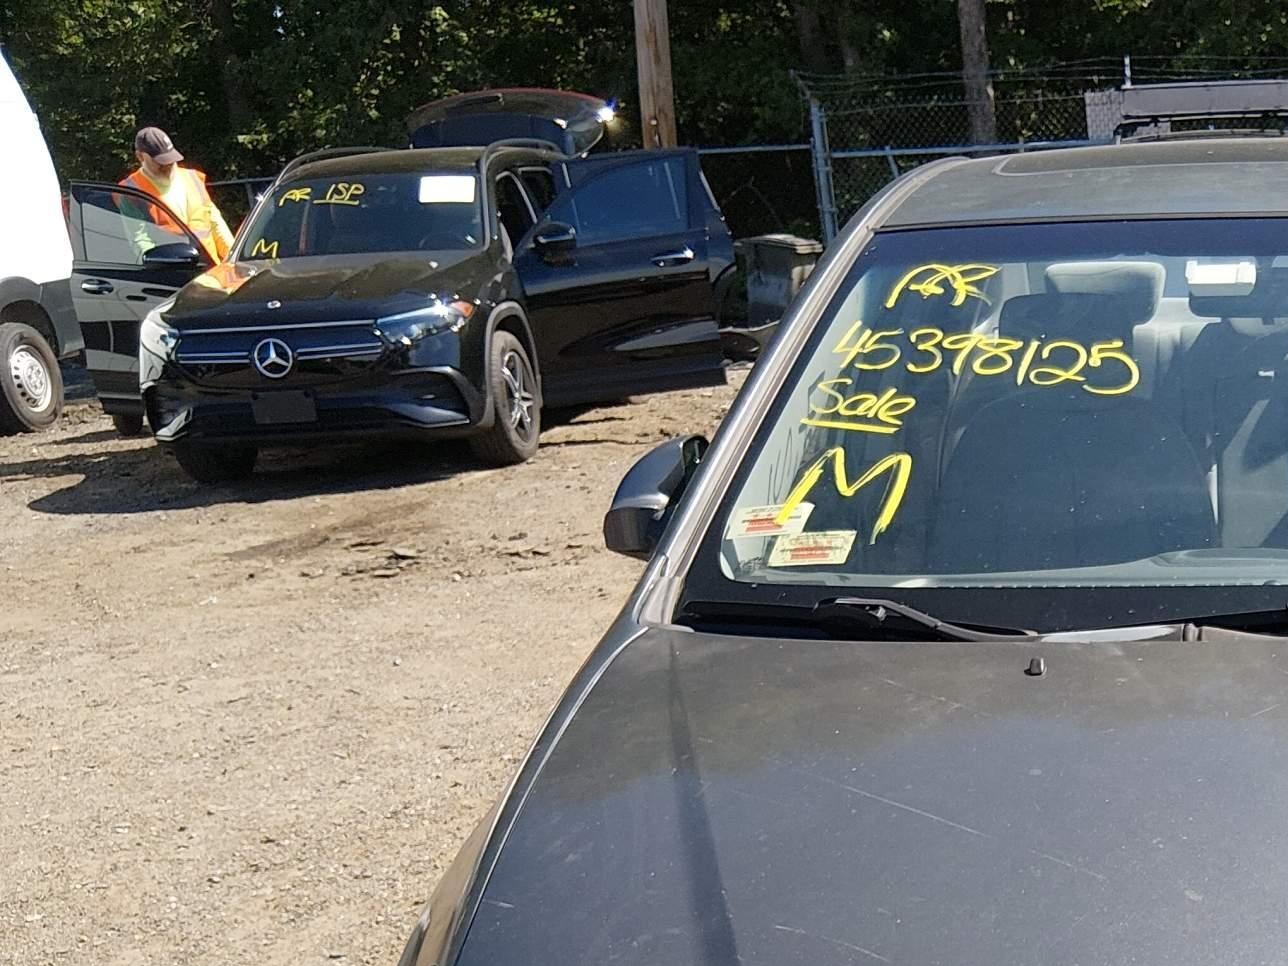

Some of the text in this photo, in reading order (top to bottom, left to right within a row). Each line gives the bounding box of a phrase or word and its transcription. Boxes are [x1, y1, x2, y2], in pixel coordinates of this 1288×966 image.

[251, 240, 278, 258] M
[832, 319, 1140, 395] 45398125
[811, 377, 916, 426] Sale
[775, 446, 912, 545] M
